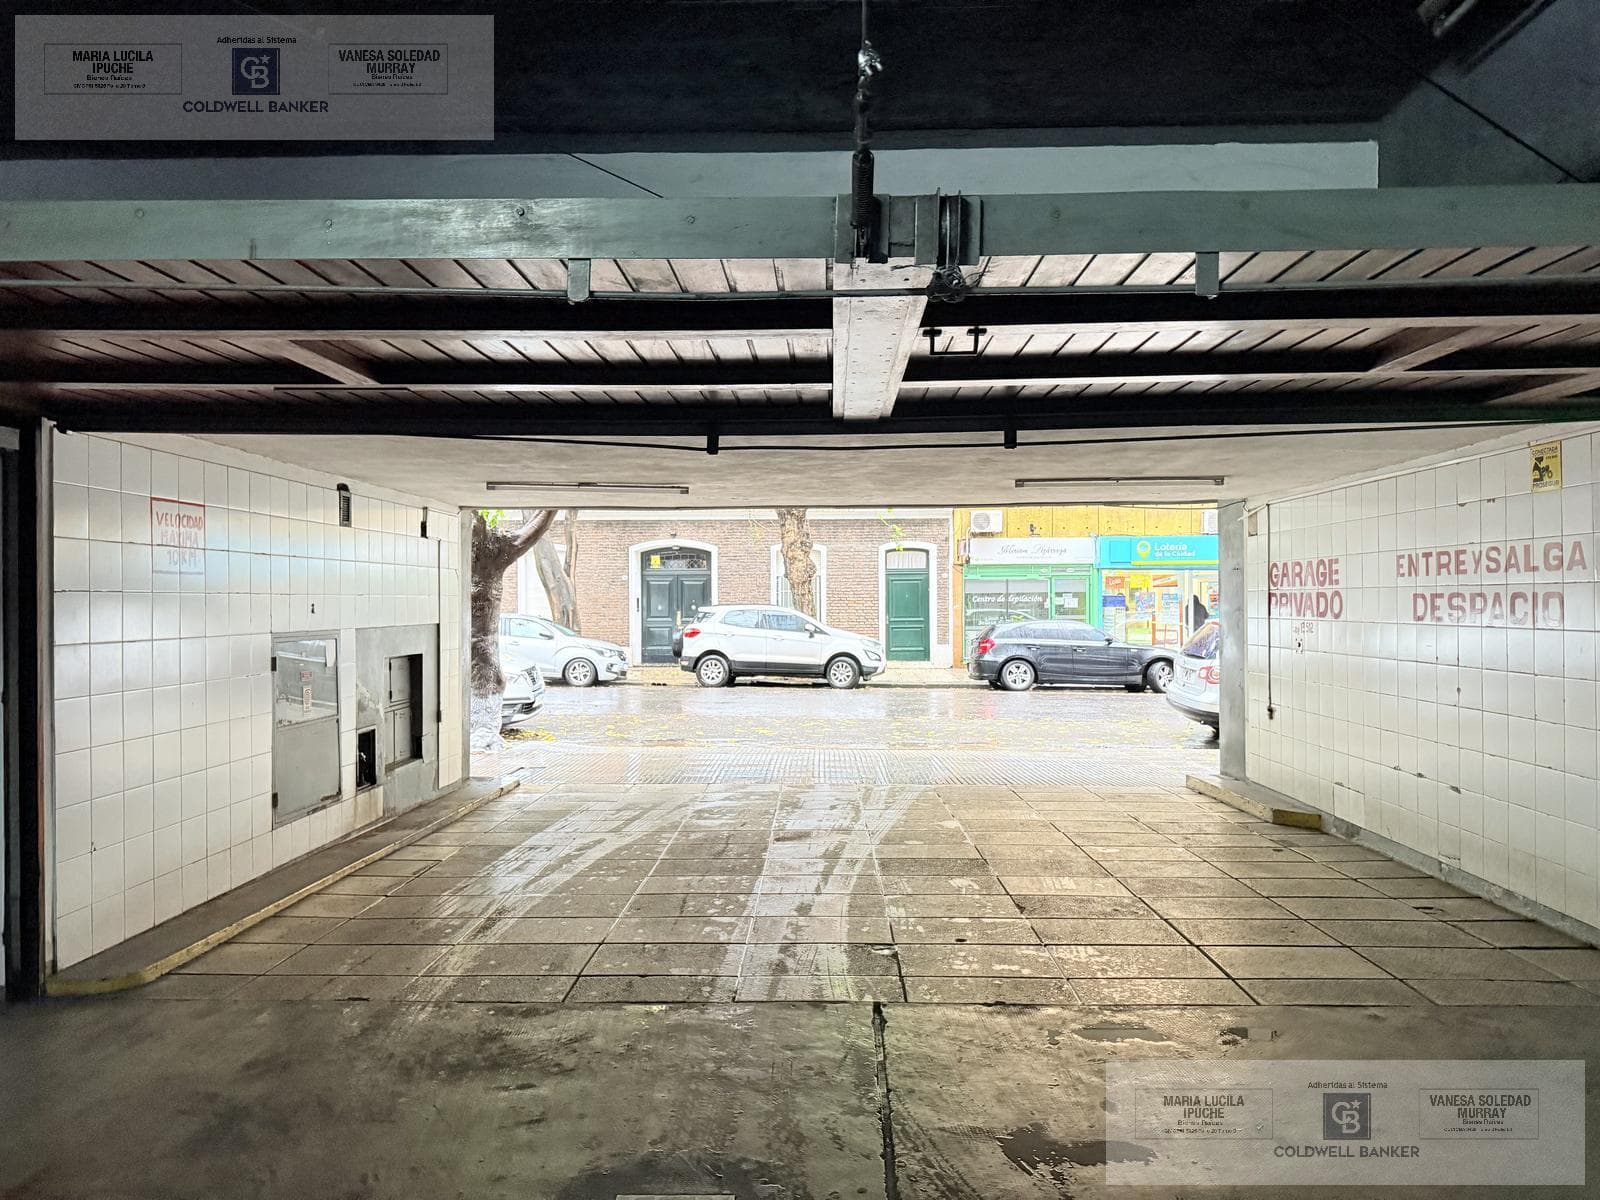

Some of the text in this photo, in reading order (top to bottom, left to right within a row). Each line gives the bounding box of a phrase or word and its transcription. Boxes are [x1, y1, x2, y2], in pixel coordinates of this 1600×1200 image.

[156, 511, 204, 531] VELOCIDAD
[1269, 558, 1340, 588] GARAGE
[1395, 549, 1468, 578] ENTRE
[1485, 541, 1588, 574] SALGA
[972, 595, 996, 603] Centro
[1268, 590, 1343, 620] PRIVADO
[1412, 591, 1564, 628] DESPACIO
